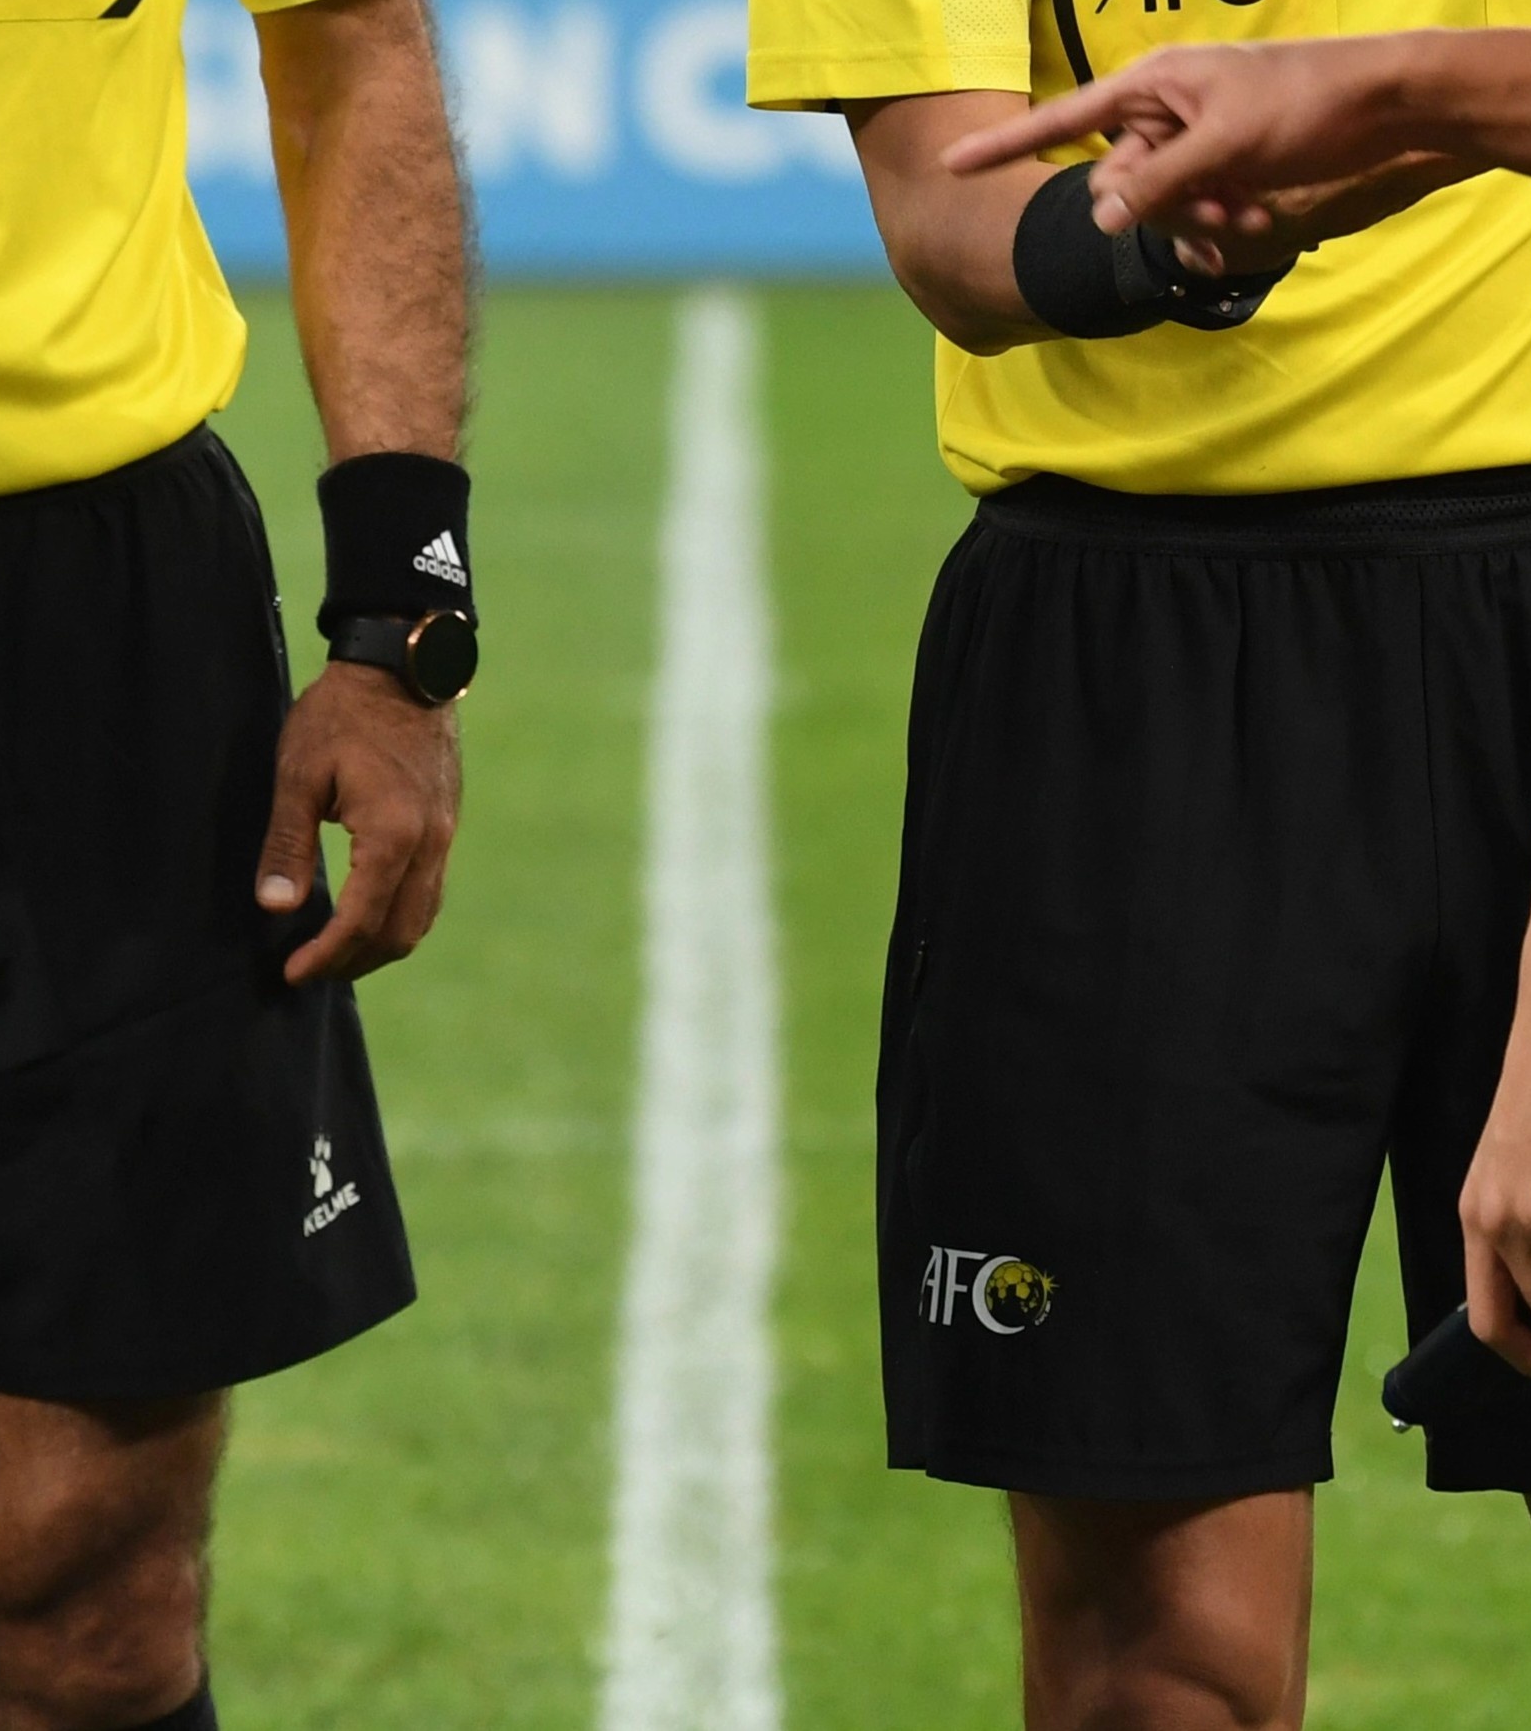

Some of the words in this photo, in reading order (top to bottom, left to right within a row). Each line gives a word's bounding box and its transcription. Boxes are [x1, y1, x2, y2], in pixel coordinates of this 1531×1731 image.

[413, 554, 467, 588] adidas
[303, 1181, 361, 1238] KELME
[919, 1244, 1026, 1335] AFC
